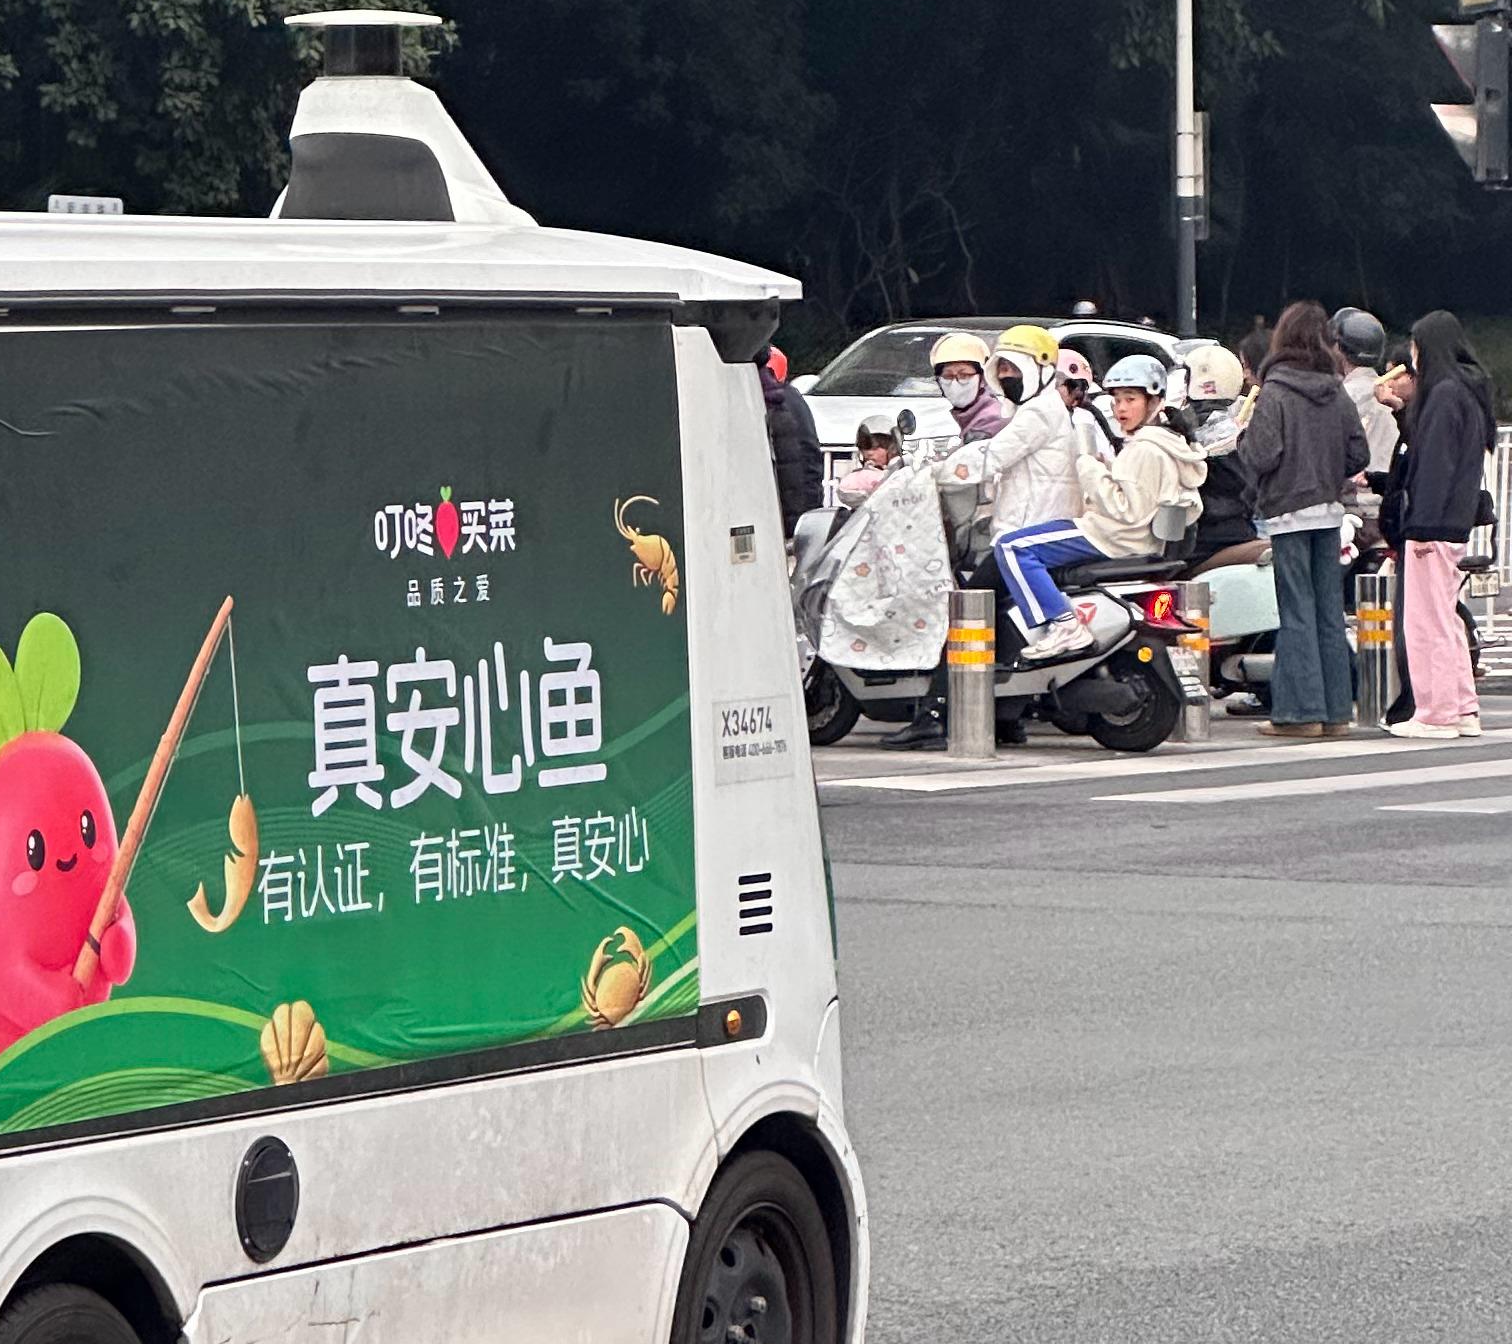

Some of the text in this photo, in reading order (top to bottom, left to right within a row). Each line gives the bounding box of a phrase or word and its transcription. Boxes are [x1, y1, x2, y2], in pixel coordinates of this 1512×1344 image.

[374, 498, 516, 559] 叮咚买菜
[406, 574, 491, 607] 品质之爱
[306, 636, 608, 817] 真安心鱼
[721, 705, 773, 738] X34674
